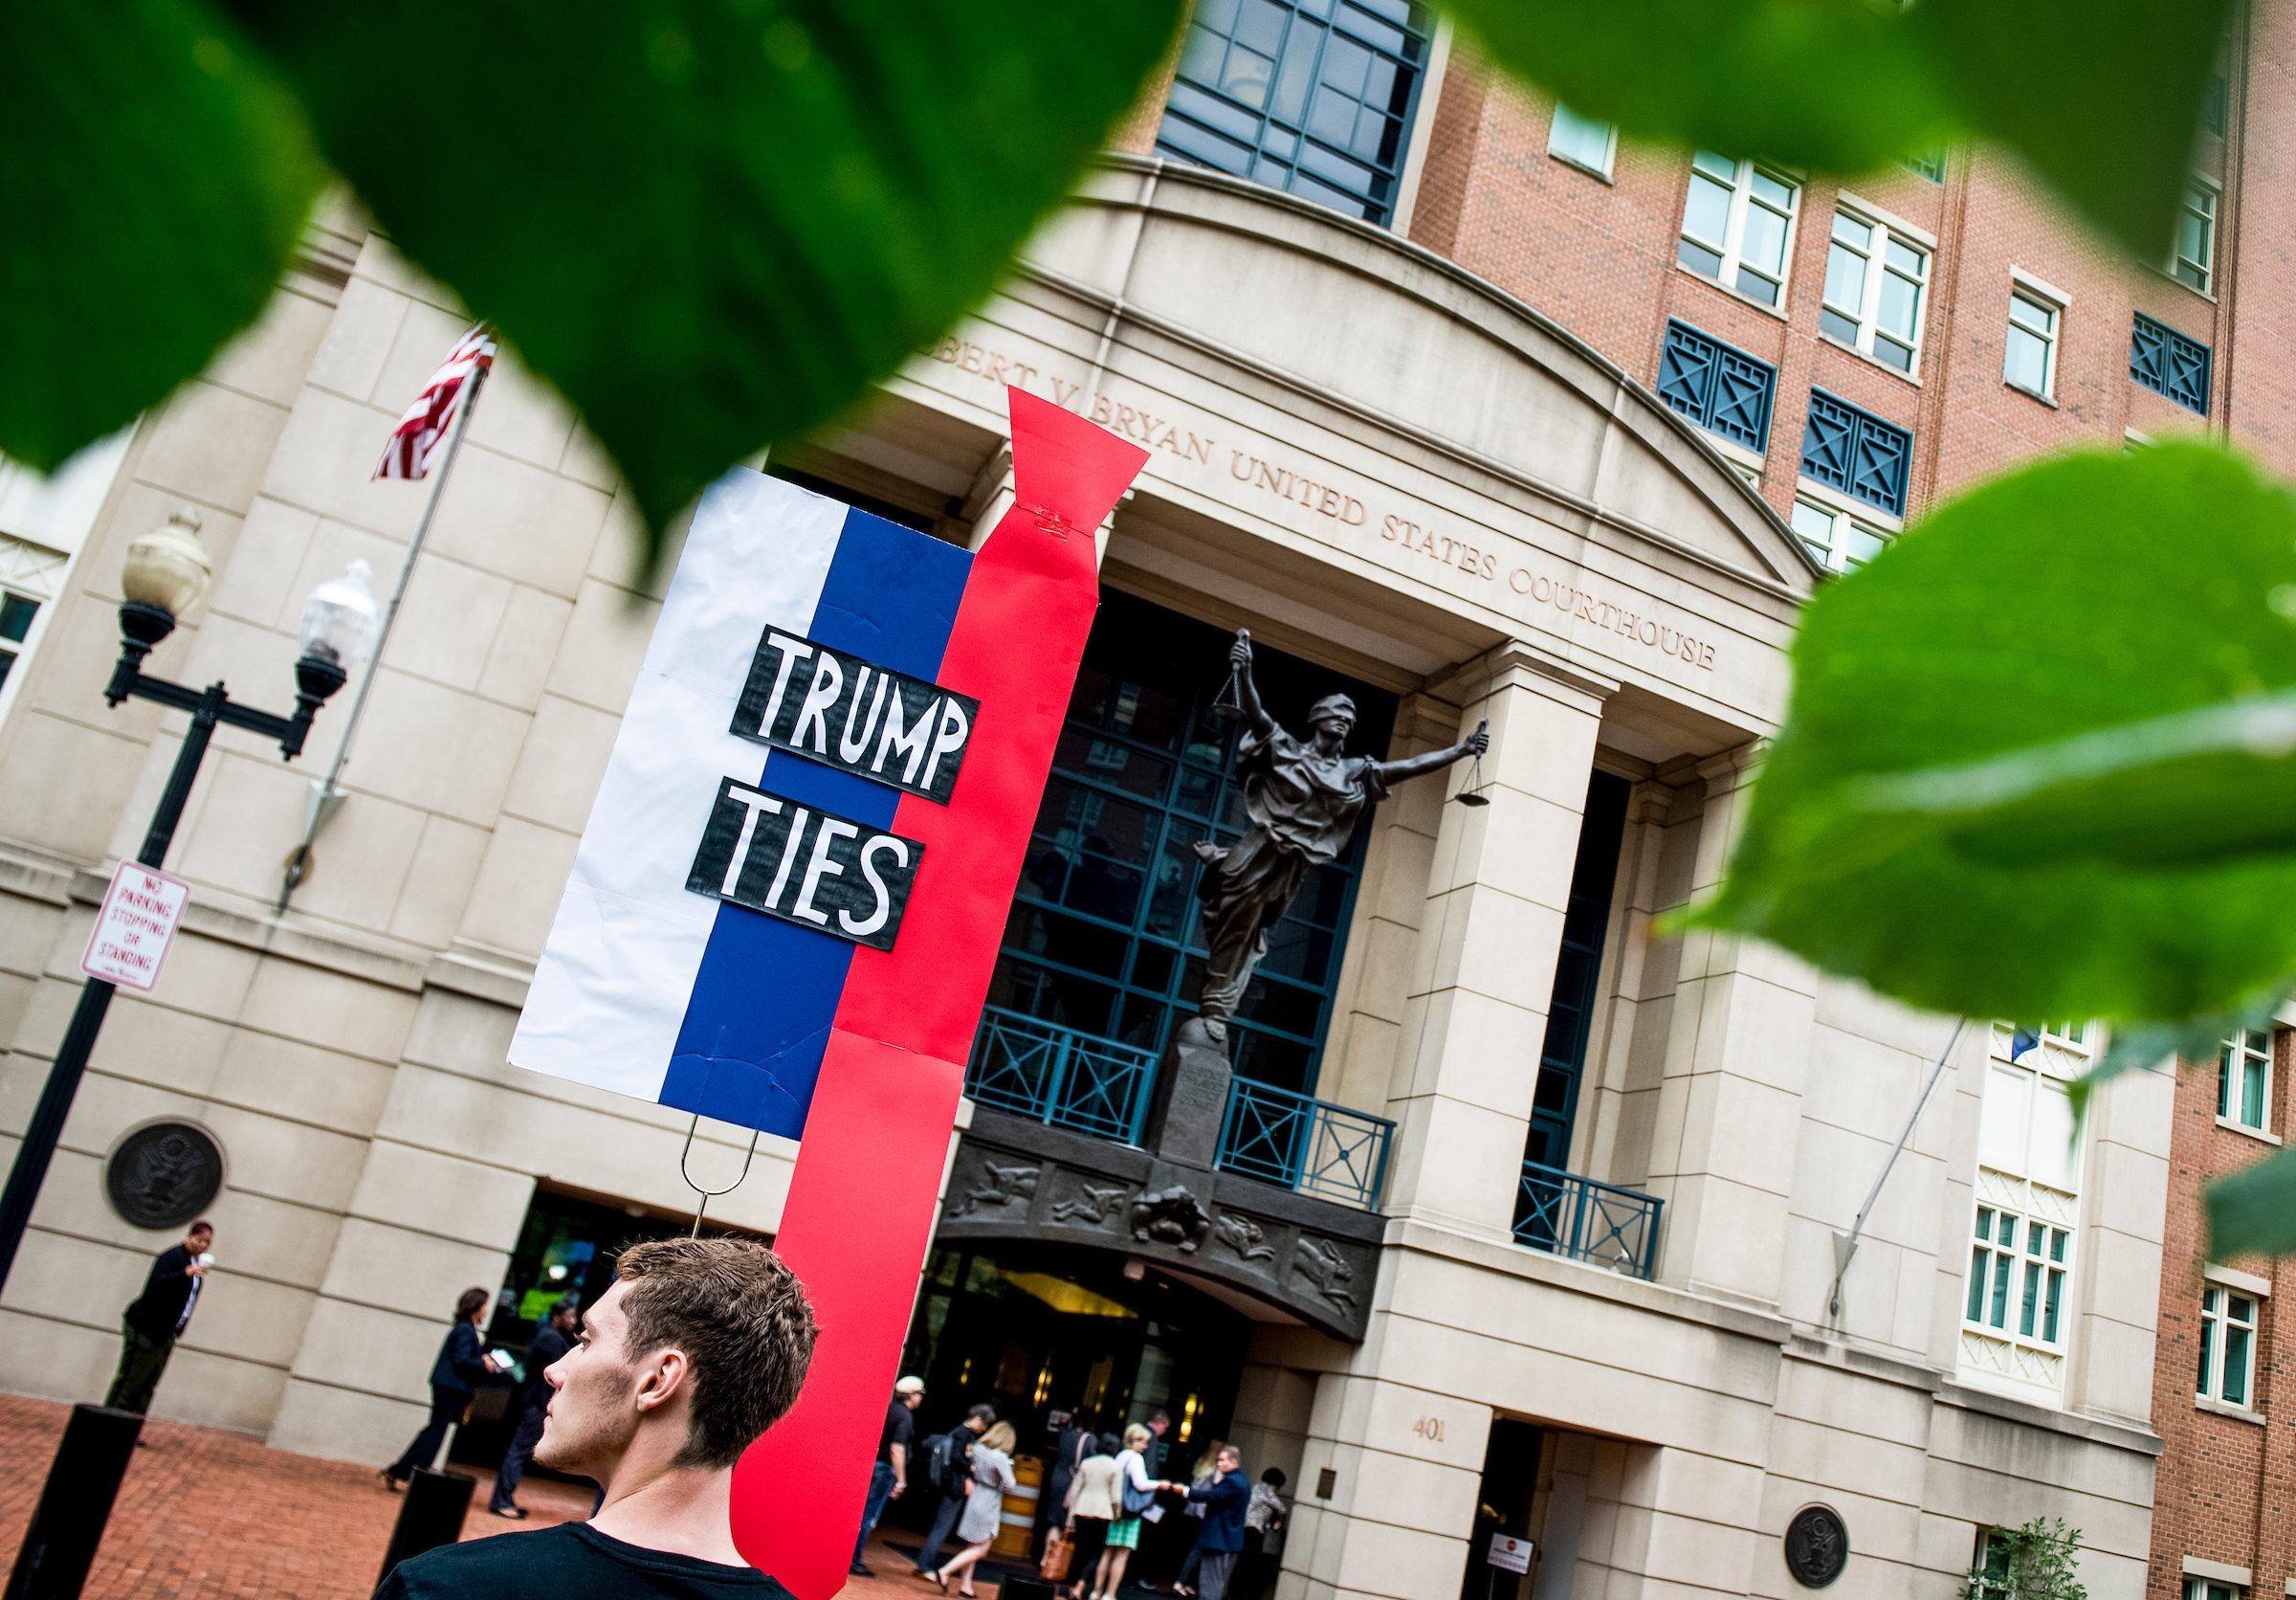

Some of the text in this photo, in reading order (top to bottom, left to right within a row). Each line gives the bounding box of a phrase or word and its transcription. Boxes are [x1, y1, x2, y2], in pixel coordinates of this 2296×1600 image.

[931, 335, 1038, 389] BERT
[1089, 392, 1215, 465] BRYAN
[1230, 449, 1368, 526] UNITED
[1380, 513, 1497, 582] STATES
[1509, 567, 1716, 672] COURTHOUSE
[757, 632, 969, 790] TRUMP
[720, 785, 909, 936] TIES
[143, 877, 162, 894] NO
[119, 887, 171, 918] PARKING
[111, 907, 166, 937] STOPPING
[124, 931, 140, 945] OR
[99, 943, 151, 970] STANDING
[1413, 1415, 1446, 1443] 401
